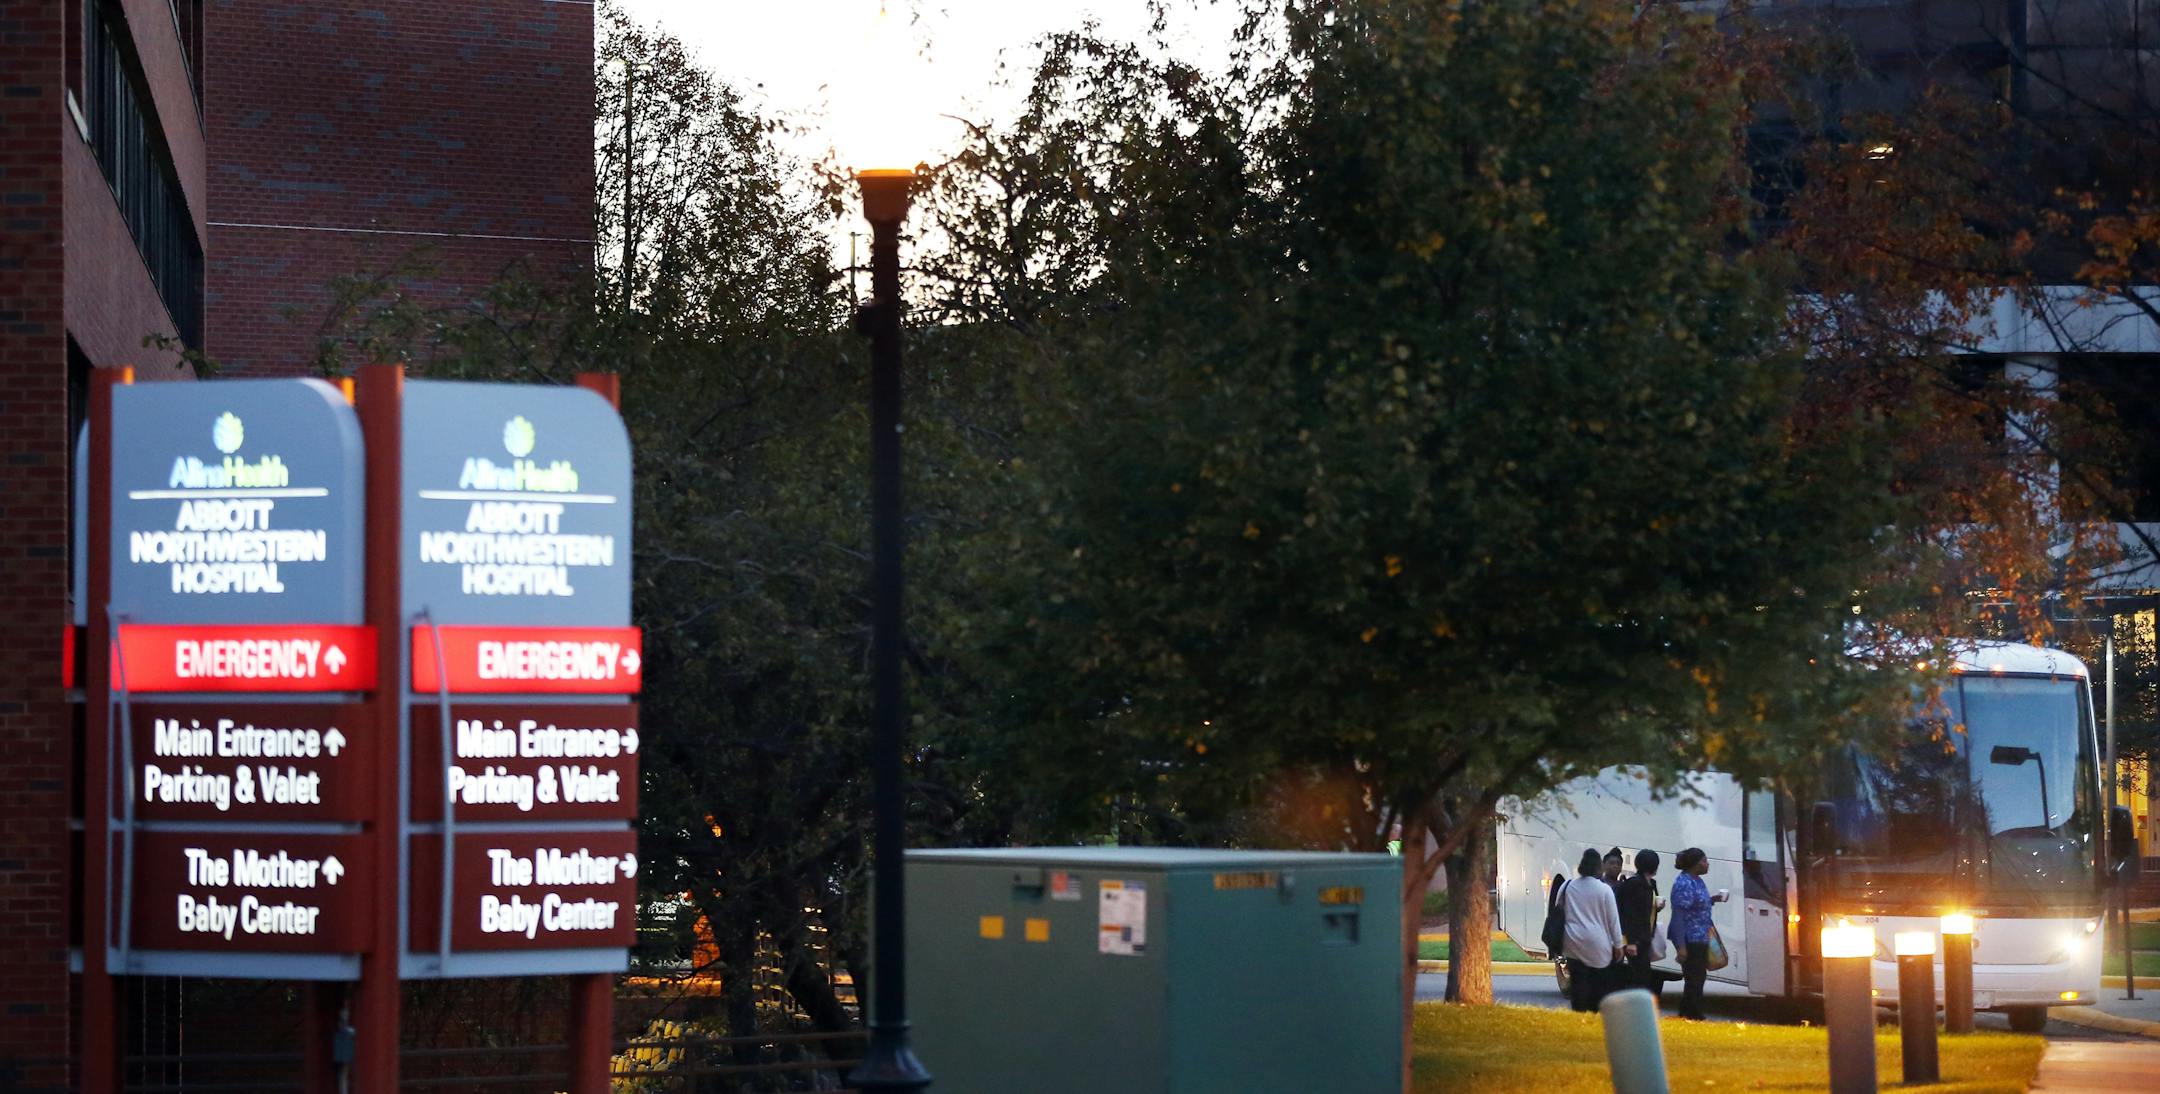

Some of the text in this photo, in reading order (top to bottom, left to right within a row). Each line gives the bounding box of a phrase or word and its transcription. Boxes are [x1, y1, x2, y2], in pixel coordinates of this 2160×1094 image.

[176, 499, 274, 531] ABBOTT
[466, 501, 564, 534] ABBOTT
[130, 530, 326, 563] NORTHWESTERN
[420, 531, 614, 566] NORTHWESTERN
[172, 563, 284, 593] HOSPITAL
[462, 563, 574, 596] HOSPITAL
[176, 640, 320, 677] EMERGENCY
[479, 641, 620, 679] EMERGENCY
[155, 720, 320, 757] Main Entrance
[457, 720, 621, 758] Main Entrance
[145, 765, 320, 810] Parking & Valet
[447, 765, 619, 811] Parking & Valet
[185, 849, 319, 888] The Mother
[488, 848, 619, 886] The Mother
[179, 895, 319, 940] Baby Center
[481, 893, 618, 939] Baby Center
